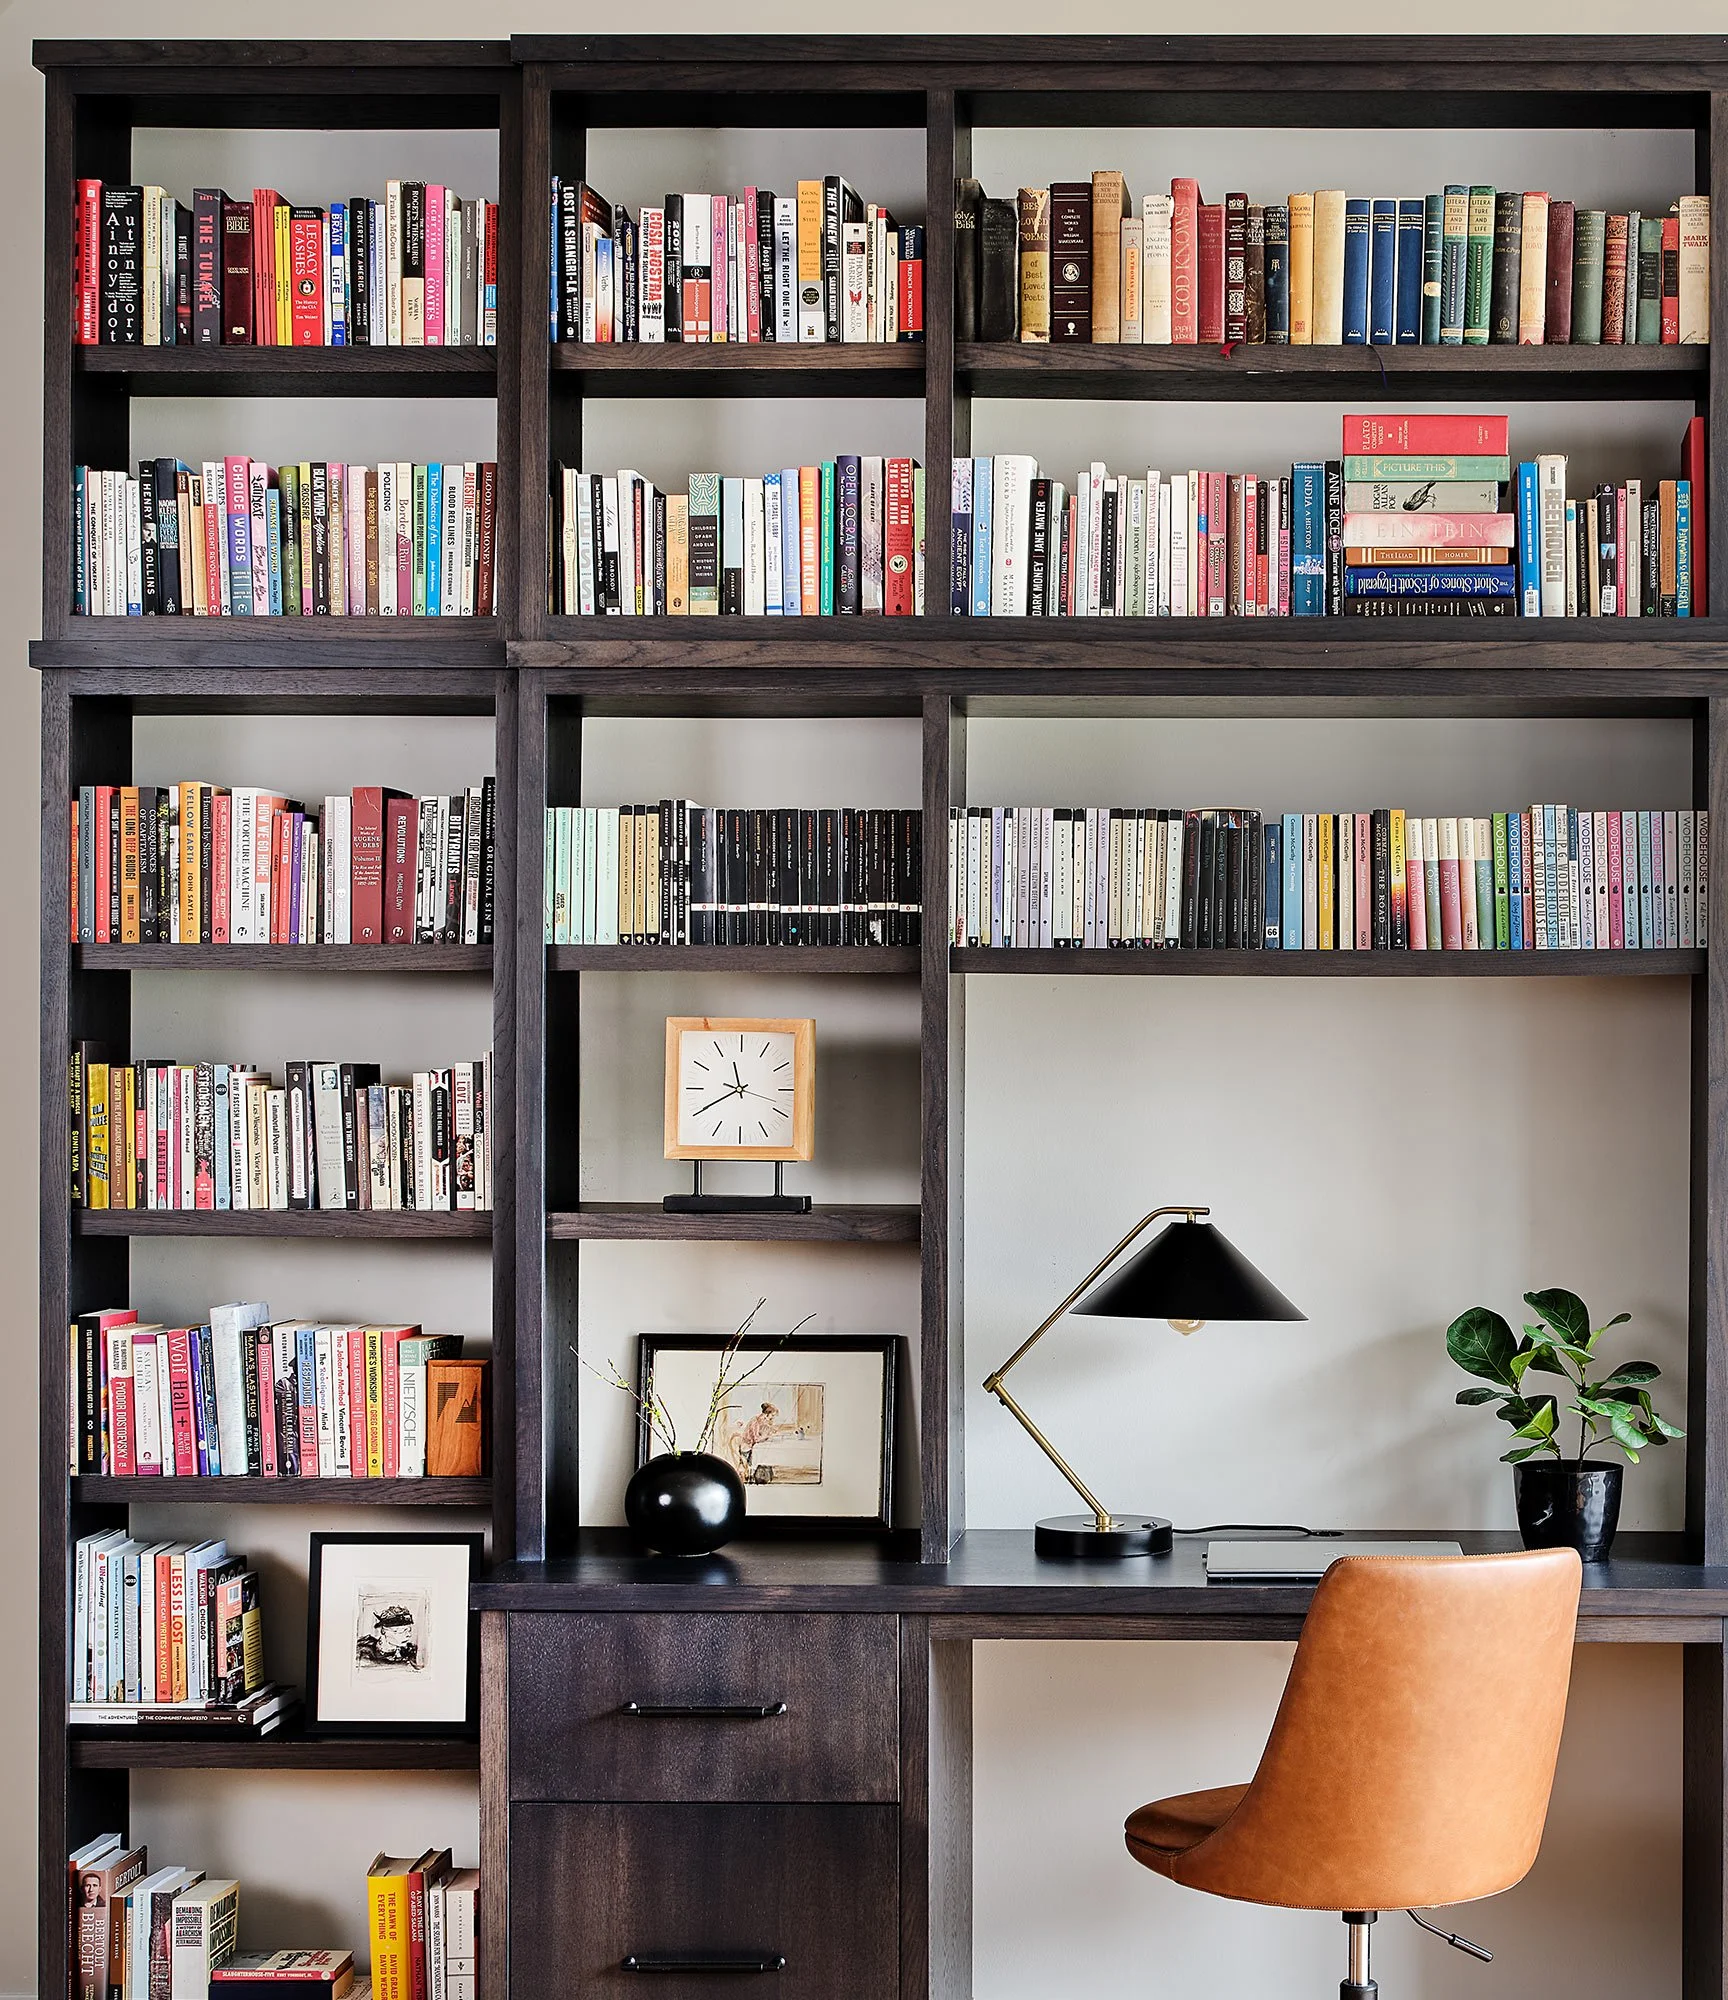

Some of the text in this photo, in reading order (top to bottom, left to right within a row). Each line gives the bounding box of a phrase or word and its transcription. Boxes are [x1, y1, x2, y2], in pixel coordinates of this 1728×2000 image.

[226, 221, 250, 232] BIBLE
[332, 213, 340, 245] BRAIN
[389, 194, 397, 260] Frank McCourt
[412, 190, 420, 266] ROGET'S THESAURUS
[563, 186, 578, 294] LOST IN SHANGRI-LA
[827, 187, 837, 245] THEY KNEW
[200, 215, 213, 312] THE TUNNEL
[295, 224, 306, 275] of ASHES
[306, 224, 317, 275] LEGACY
[649, 211, 662, 301] COSA NOSTRA
[762, 245, 772, 298] Joseph Heller
[782, 231, 790, 317] LET THE RIGHT ONE IN
[1175, 206, 1190, 315] GOD KNOWS
[427, 277, 436, 320] COATES
[1362, 420, 1371, 451] PLATO
[217, 468, 225, 506] TRAMPS
[233, 464, 247, 562] CHOICE WORDS
[313, 468, 325, 517] BLACK POWER
[383, 471, 391, 511] POLICING
[448, 486, 456, 546] BLOOD RED LINES
[845, 465, 856, 557] OPEN SOCRATES
[889, 463, 898, 525] THE BEGINNING
[900, 463, 909, 525] STAMPED FROM
[1304, 476, 1313, 507] INDIA
[1328, 472, 1341, 536] ANNE RICE
[143, 483, 155, 595] HENRY ROLLINS
[803, 481, 814, 596] ON FIRE NAOMI KLEIN
[1032, 501, 1046, 617] DARK MONEY JANE MAYER
[1304, 517, 1313, 549] HISTORY
[1545, 489, 1562, 583] BEETHOVEN
[1147, 581, 1155, 615] RUSSELL
[140, 809, 147, 821] OF
[186, 789, 194, 829] YELLOW
[202, 796, 211, 870] Haunted by Slavery
[257, 803, 270, 877] HOW WE GO HOME
[468, 796, 481, 879] ORGANIZING POWER
[126, 805, 136, 881] THE LONG DEEP GRUDGE
[186, 833, 194, 864] EARTH
[1497, 818, 1505, 885] WODEHOUSE
[1610, 817, 1619, 883] WODEHOUSE
[1698, 817, 1707, 882] WODEHOUSE
[485, 845, 494, 921] ORIGINAL SIN
[1546, 842, 1555, 933] P.G. WODEHOUSE
[198, 1070, 211, 1128] STRONGMEN
[457, 1081, 466, 1104] LOVE
[71, 1130, 79, 1172] SUNIL YAPA
[157, 1135, 166, 1184] CHANDLER
[272, 1104, 280, 1154] Immortal Poems
[345, 1112, 353, 1162] BURN THIS BOOK
[171, 1335, 188, 1411] Wolf Hall
[247, 1335, 257, 1418] MAMA'S LAST HUG
[260, 1345, 271, 1381] Jainism
[115, 1381, 127, 1459] FYODOR DOSTOEVSKY
[302, 1416, 314, 1444] RIGHT
[403, 1372, 417, 1446] NIETZSCHE
[172, 1568, 183, 1645] LESS IS LOST
[82, 1912, 95, 1976] BRECHT
[95, 1919, 105, 1969] BERTOLT
[377, 1894, 386, 1940] EVERYTHING
[388, 1892, 397, 1941] THE DAWN OF
